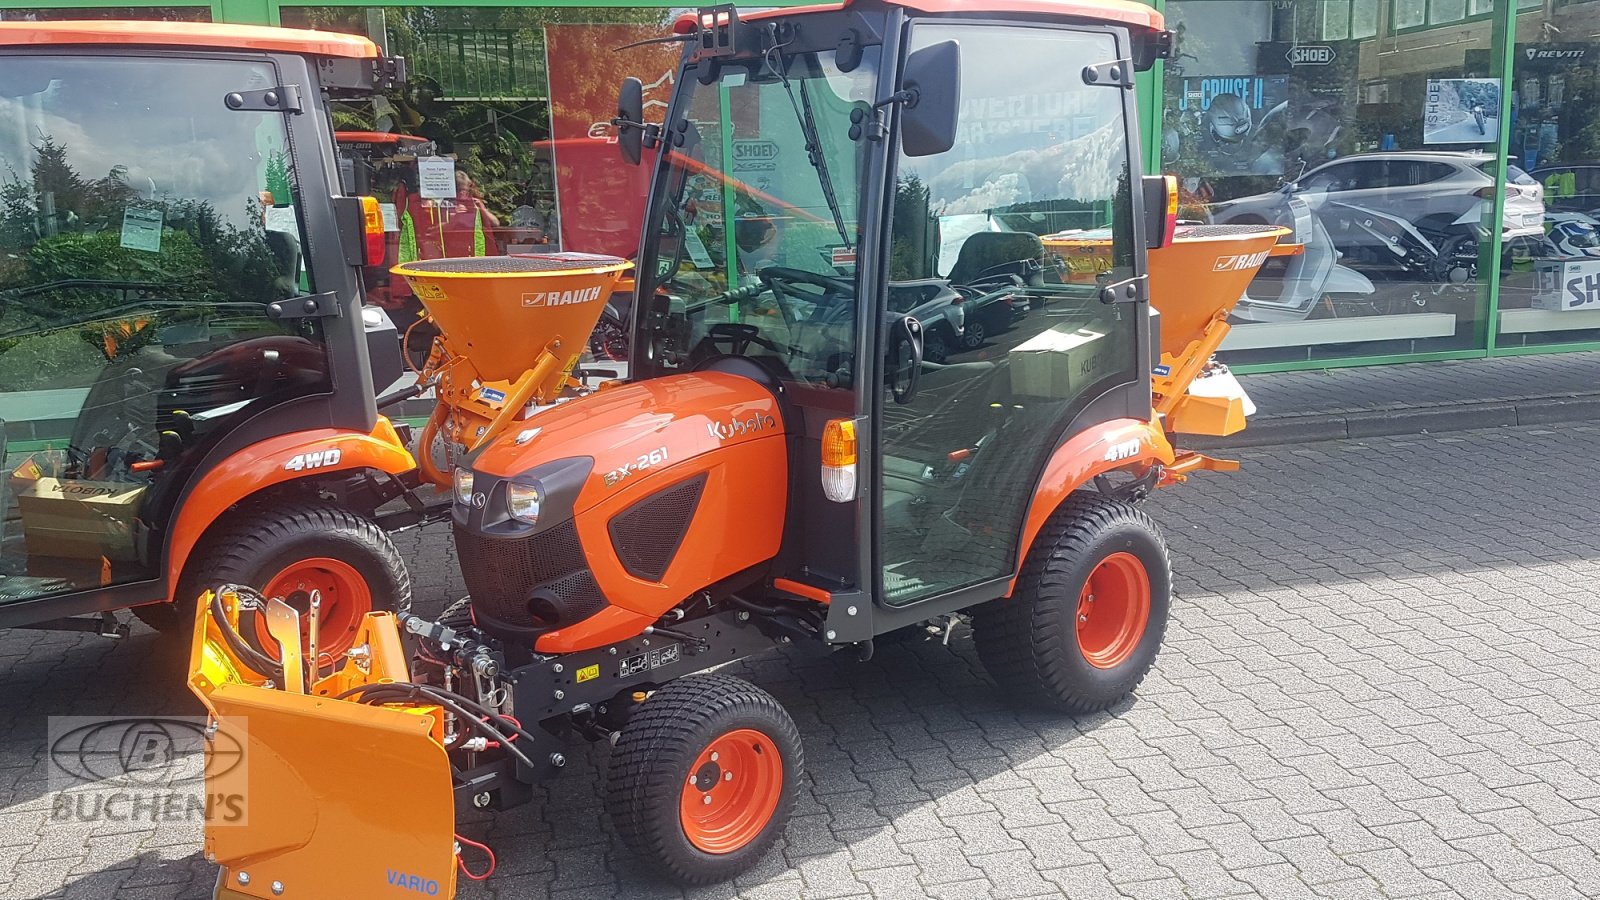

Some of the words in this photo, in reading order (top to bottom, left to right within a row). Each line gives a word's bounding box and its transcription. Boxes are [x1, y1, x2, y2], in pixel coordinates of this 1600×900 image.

[1294, 49, 1329, 62] SHOEI
[1427, 79, 1441, 123] SHOEI
[735, 144, 774, 157] SHOEI
[546, 285, 602, 306] RAUCH
[706, 412, 777, 440] Kubota
[284, 448, 342, 472] 4WD
[1104, 438, 1141, 463] 4WD
[603, 446, 669, 488] BX-261
[51, 484, 119, 499] KUBOTA
[386, 867, 439, 897] VARIO
